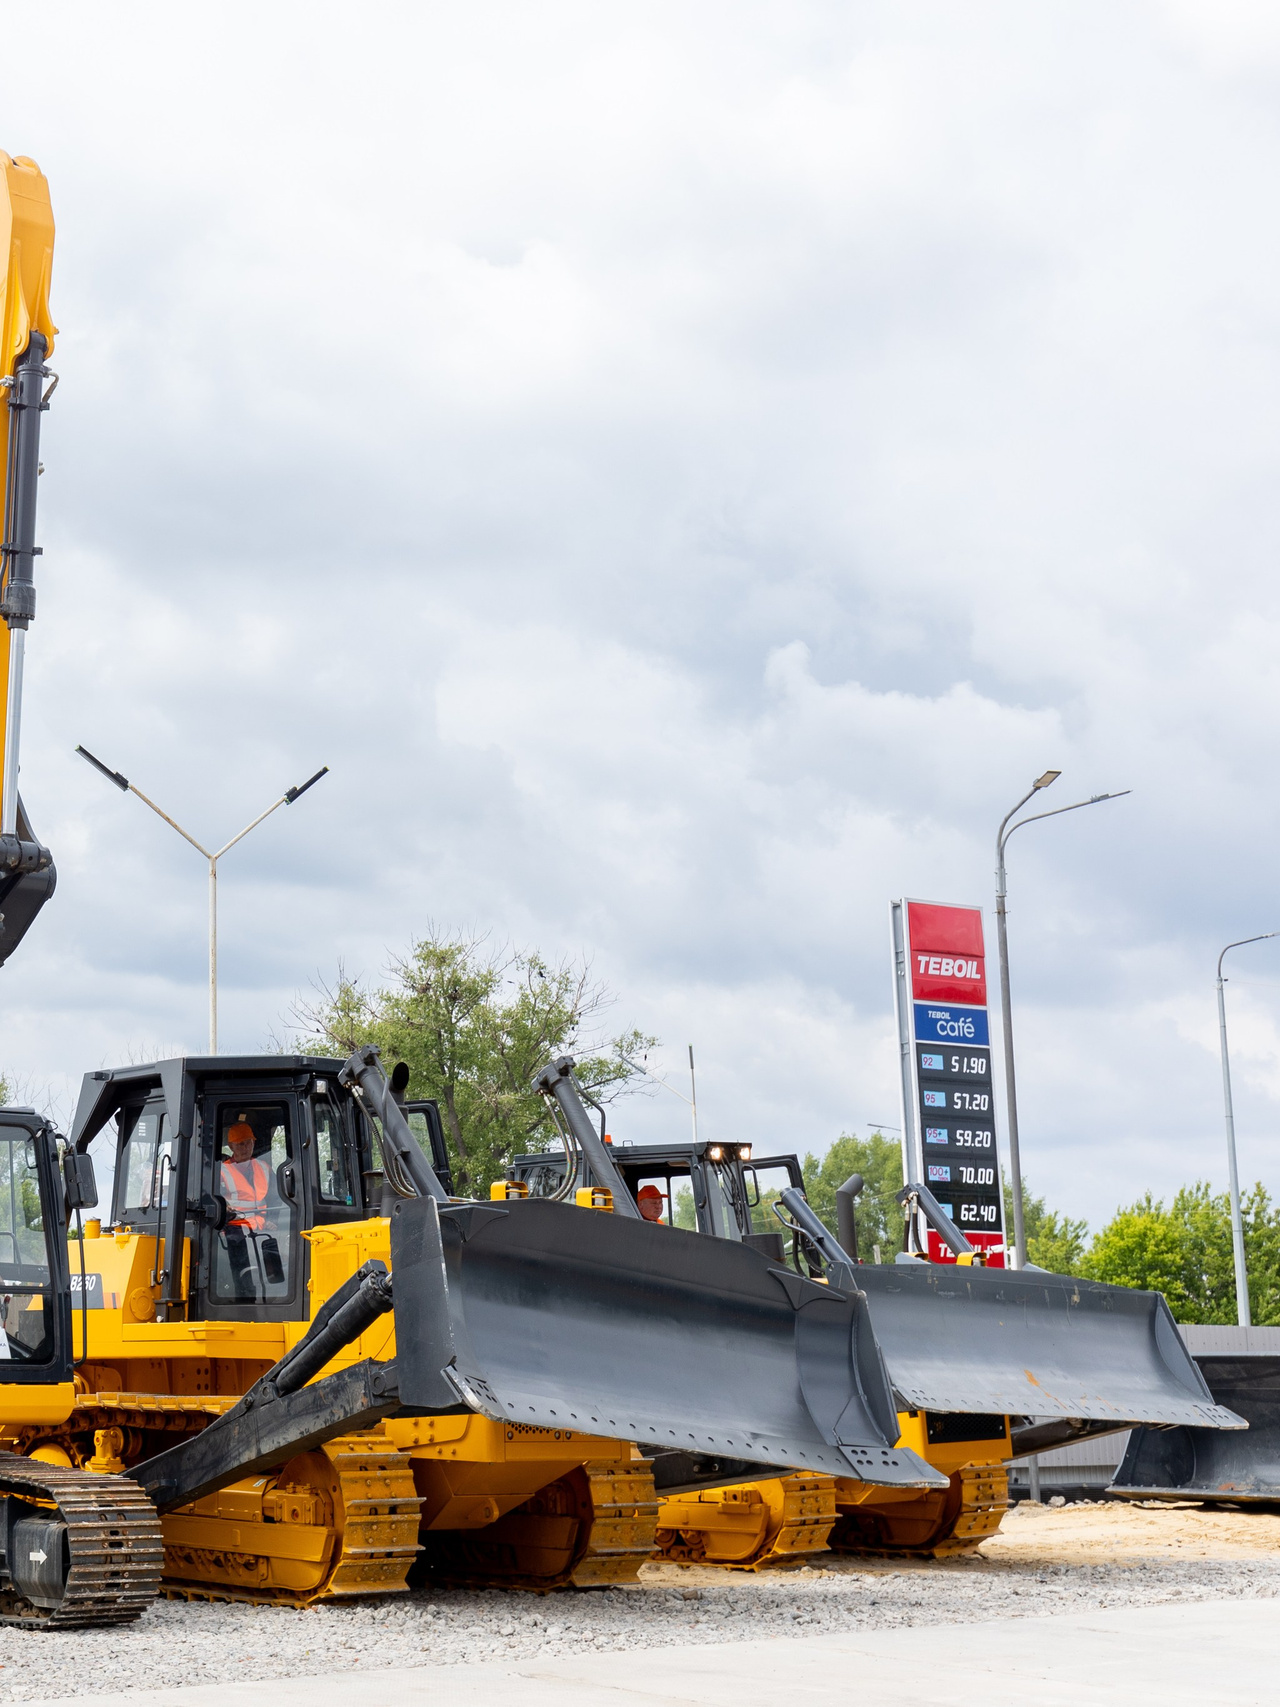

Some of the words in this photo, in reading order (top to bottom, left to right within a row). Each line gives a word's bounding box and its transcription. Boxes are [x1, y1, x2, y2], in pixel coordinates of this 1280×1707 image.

[917, 955, 981, 980] TEBOIL
[928, 1010, 951, 1020] TEBOIL
[937, 1017, 975, 1038] café
[923, 1056, 933, 1067] 92
[951, 1055, 986, 1075] 51.90
[925, 1093, 936, 1104] 95
[953, 1092, 989, 1111] 57.20
[955, 1129, 991, 1148] 59.20
[959, 1166, 994, 1185] 70.00
[960, 1204, 996, 1222] 62.40
